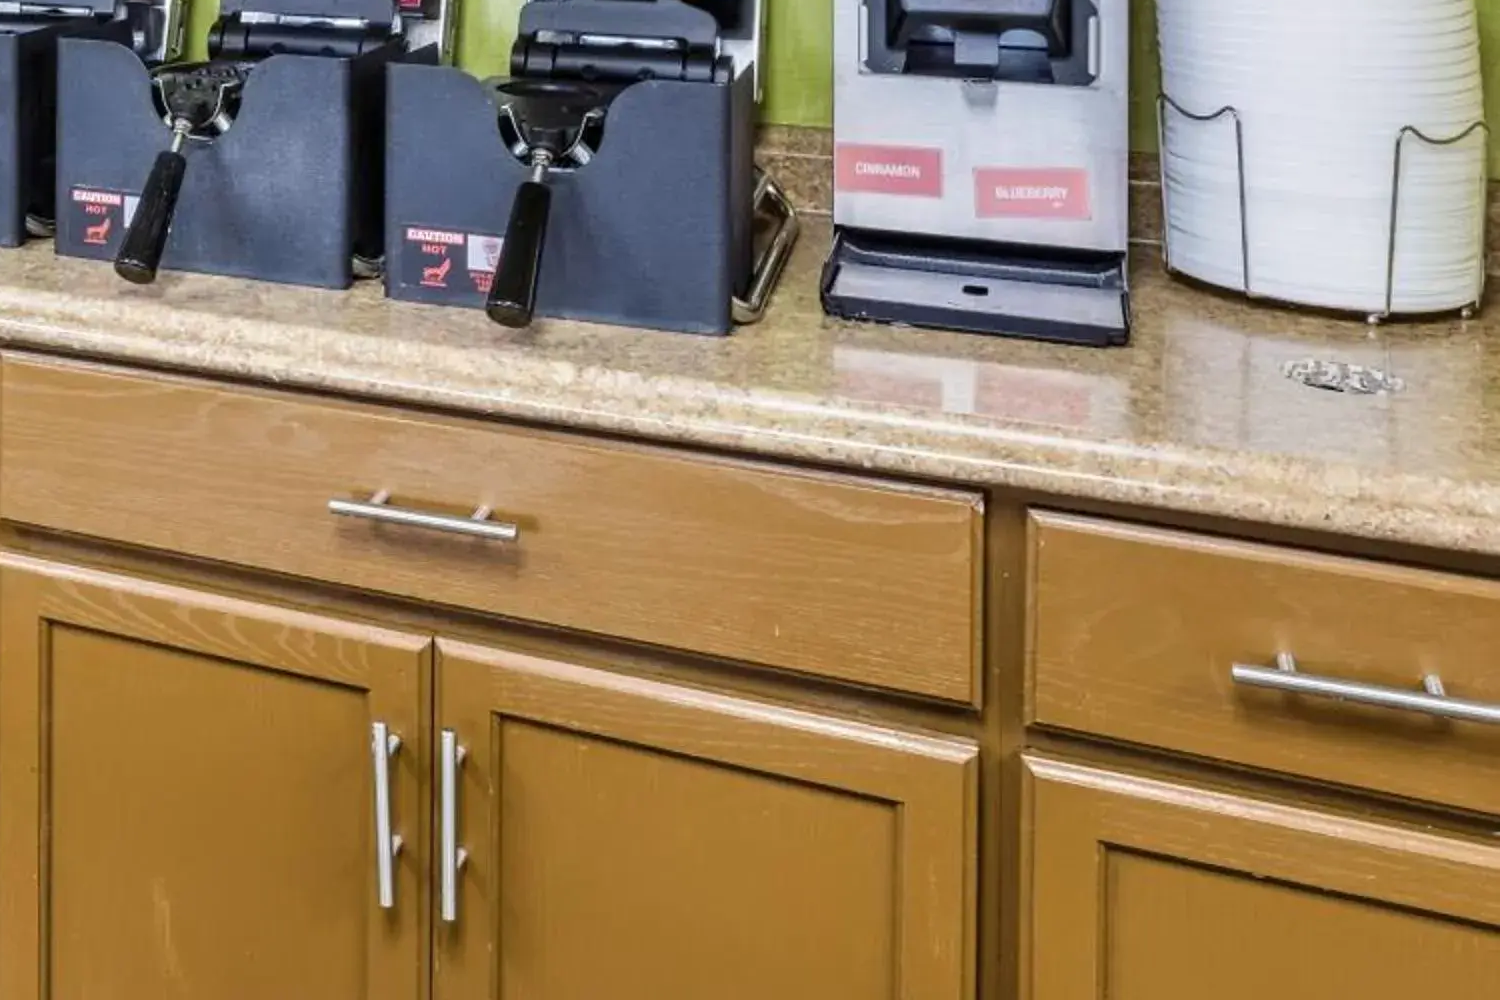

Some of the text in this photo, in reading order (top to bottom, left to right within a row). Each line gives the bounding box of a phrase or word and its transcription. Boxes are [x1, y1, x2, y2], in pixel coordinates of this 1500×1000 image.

[854, 160, 922, 179] CINNAMON
[72, 189, 121, 206] CAUTION
[994, 185, 1069, 201] BLUEBERRY
[406, 228, 464, 245] CAUTION
